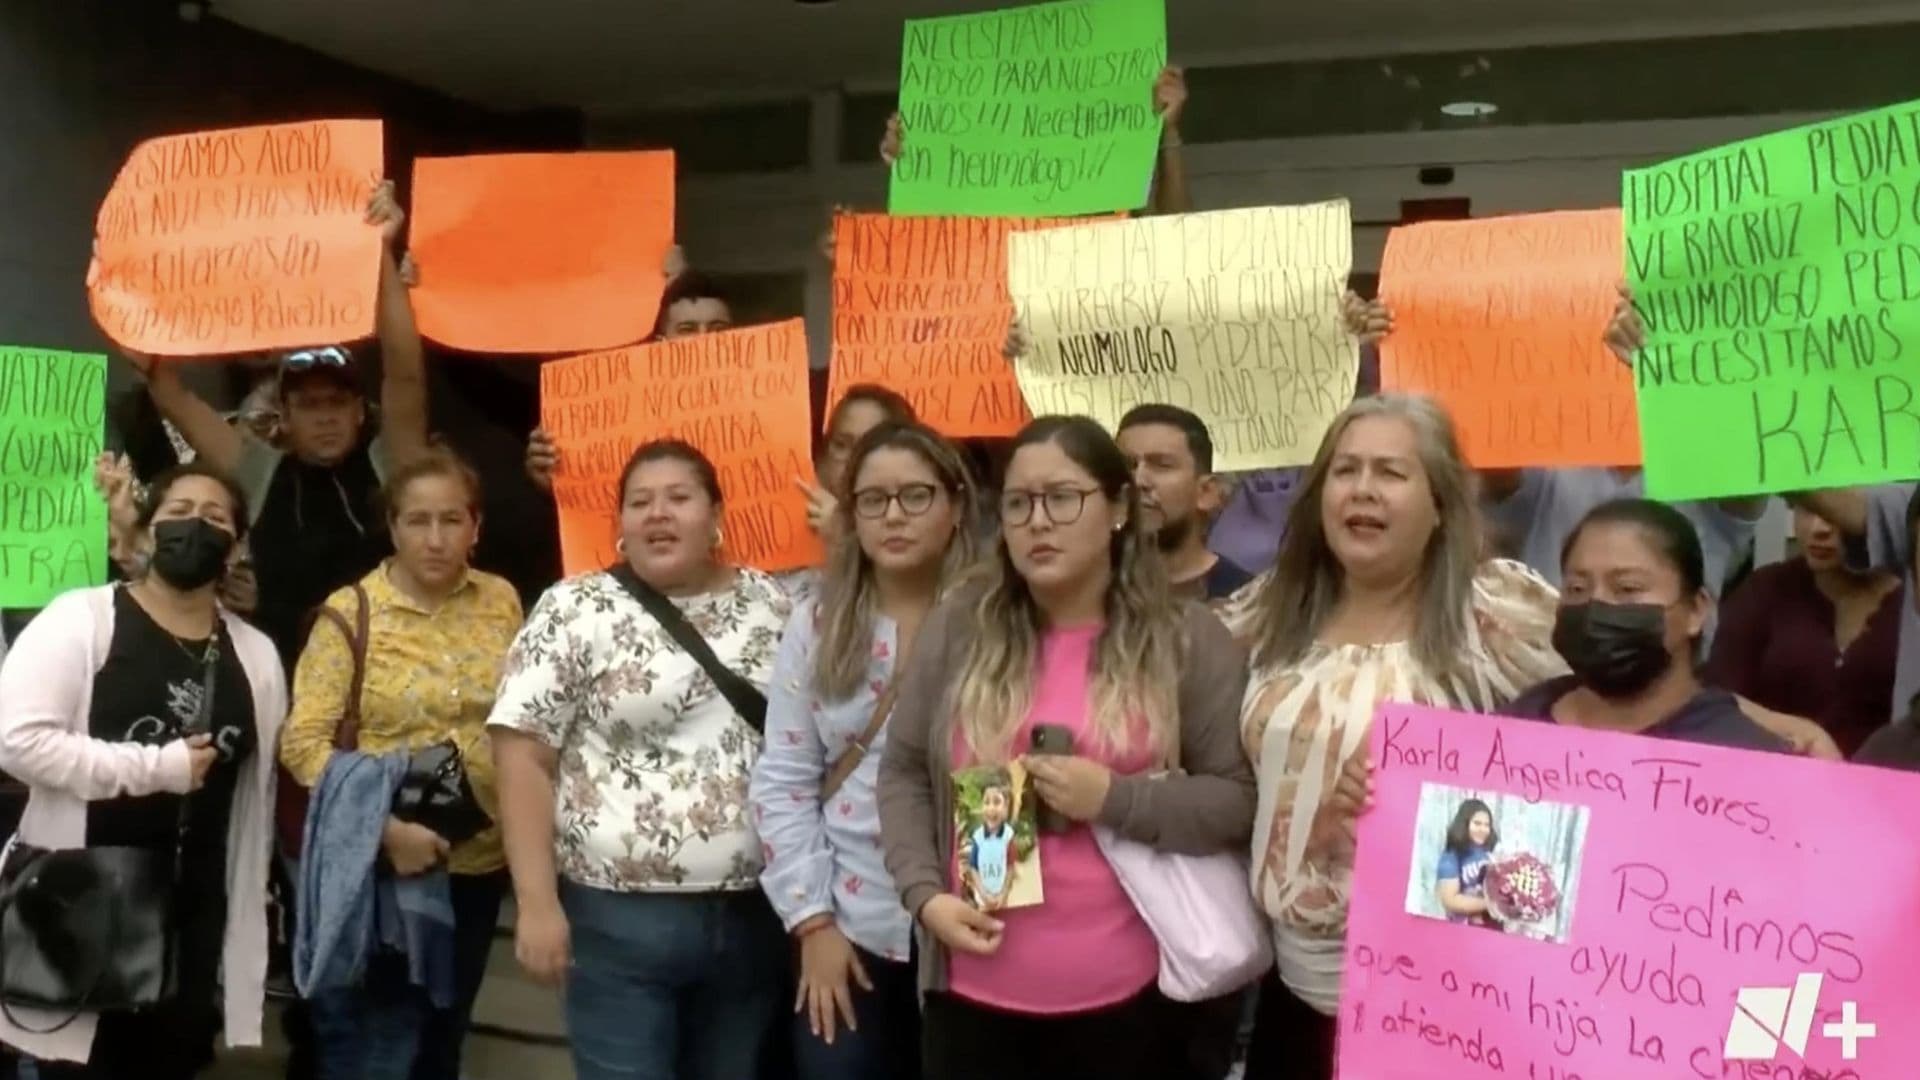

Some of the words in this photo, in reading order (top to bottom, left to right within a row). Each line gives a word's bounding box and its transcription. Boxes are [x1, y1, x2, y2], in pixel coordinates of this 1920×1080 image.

[1630, 147, 1780, 226] HOSPITAL
[1627, 202, 1803, 283] VERACRUZ
[1057, 325, 1178, 378] NEUMOLOGO
[1637, 306, 1903, 389] NECESITAMOS
[1380, 717, 1459, 774] Karla
[1353, 944, 1421, 981] que
[1528, 975, 1602, 1056] hija
[1570, 943, 1706, 1008] ayuda
[1381, 1000, 1504, 1073] atienda
